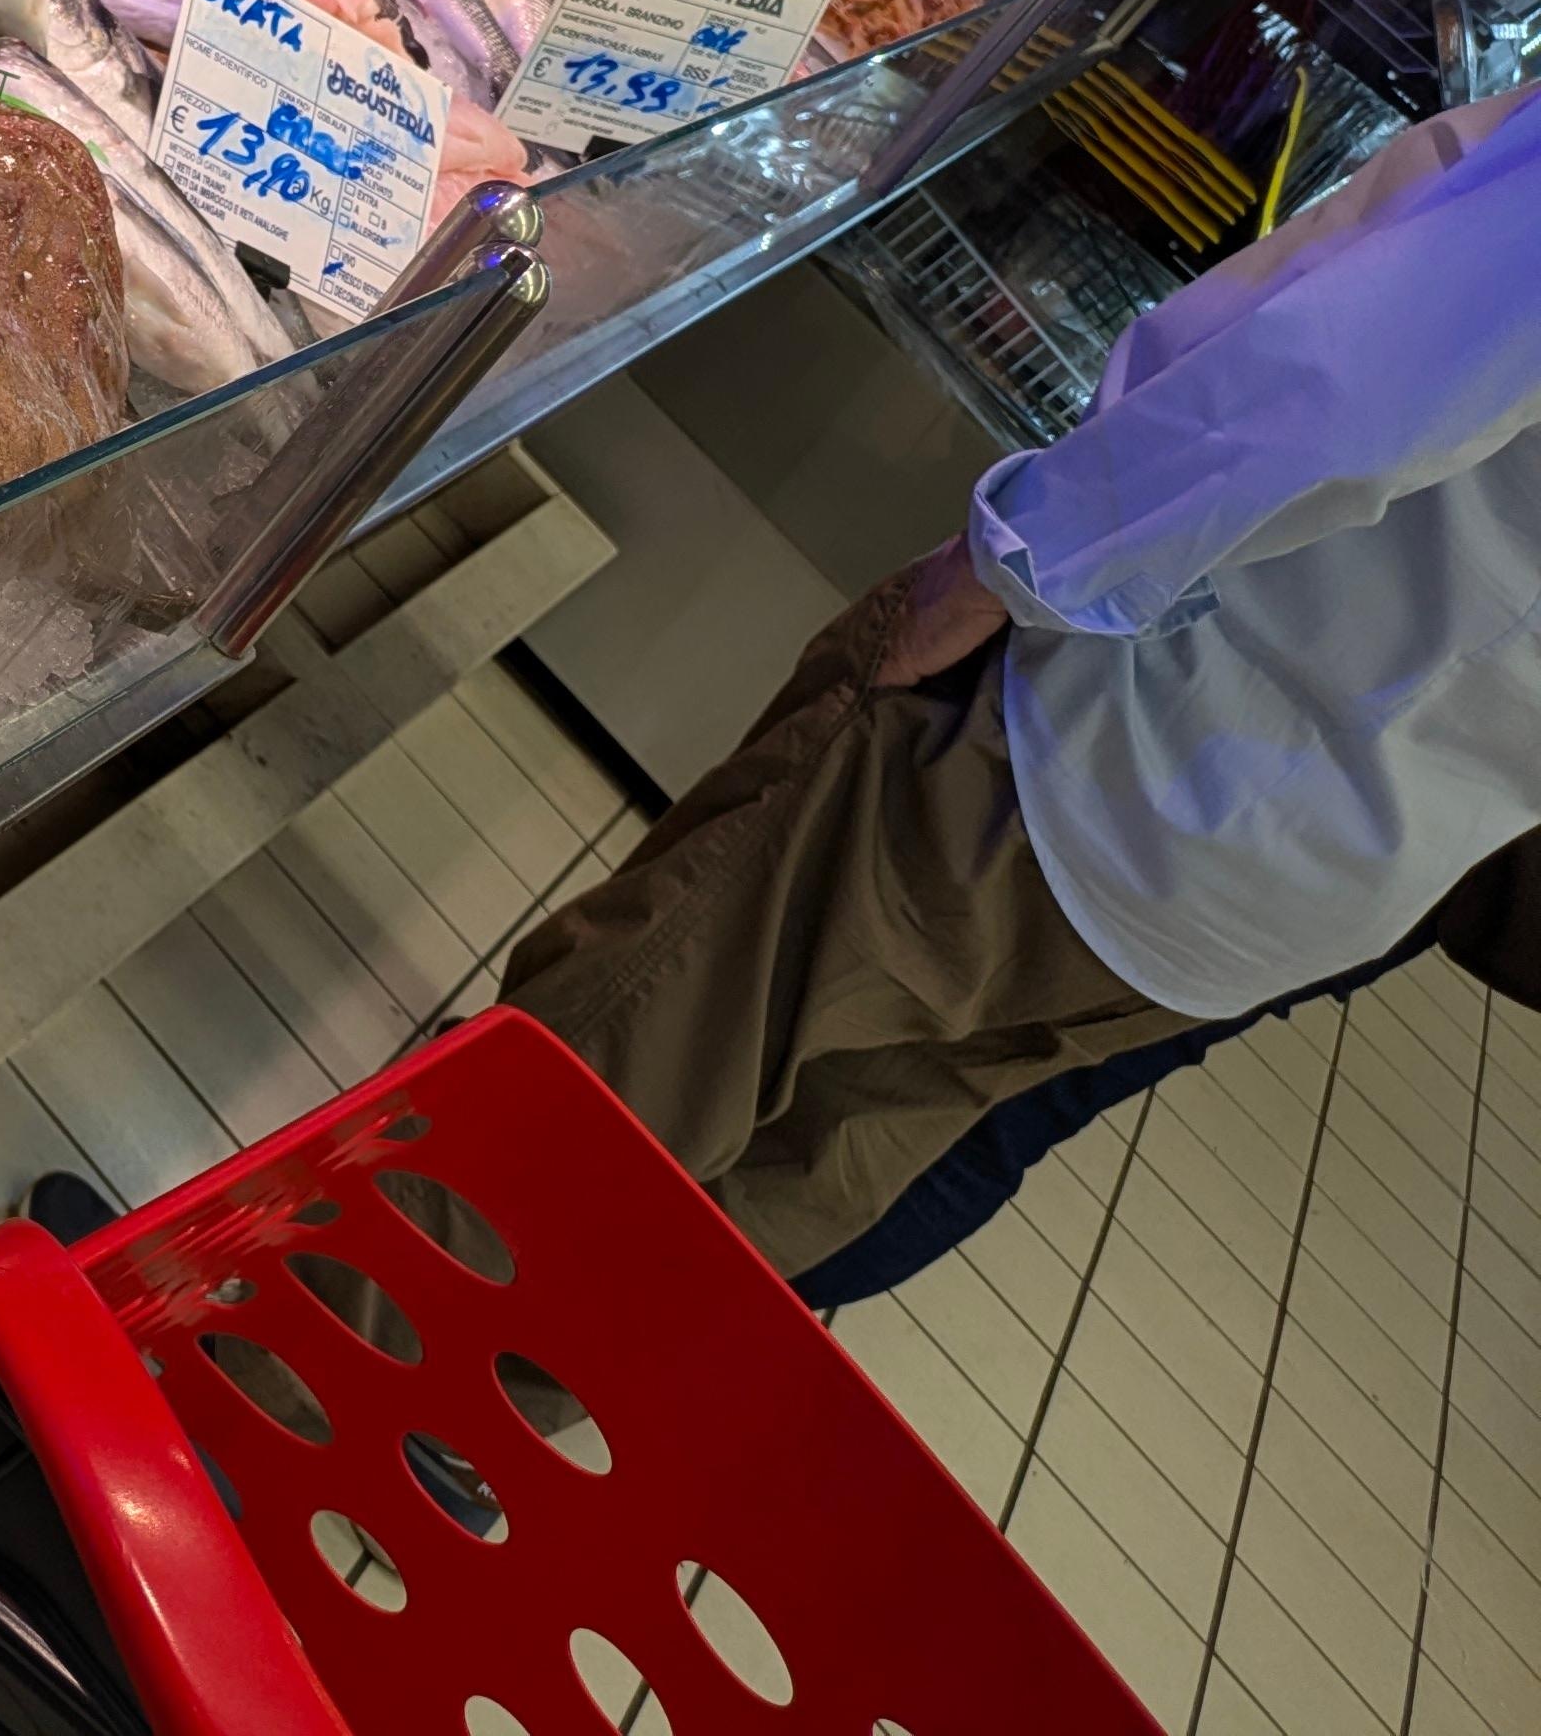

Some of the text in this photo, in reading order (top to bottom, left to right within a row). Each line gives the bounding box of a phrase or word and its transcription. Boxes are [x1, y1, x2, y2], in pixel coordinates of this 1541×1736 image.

[627, 5, 686, 30] BRANZINO
[533, 57, 552, 79] €
[681, 64, 711, 81] BSS
[169, 105, 187, 134] €
